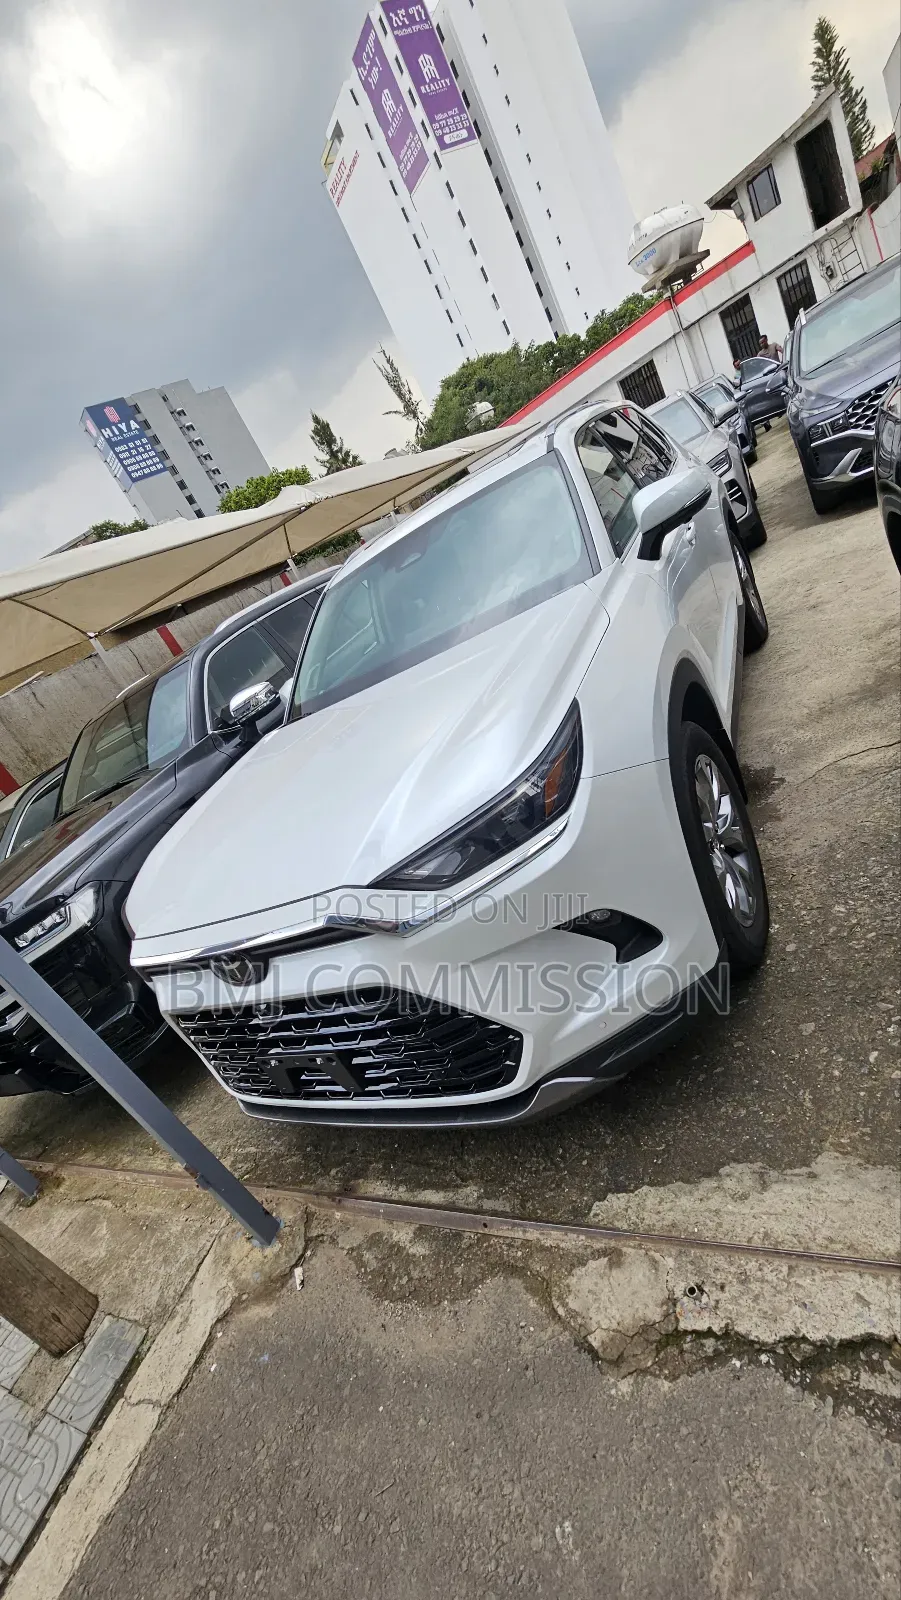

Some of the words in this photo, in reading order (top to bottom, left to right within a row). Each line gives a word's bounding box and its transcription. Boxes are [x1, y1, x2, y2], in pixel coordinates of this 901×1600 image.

[420, 78, 450, 94] REALITY
[387, 104, 404, 139] REALITY
[432, 122, 440, 130] 09
[330, 156, 347, 198] REALITY
[101, 419, 140, 439] HIYA
[123, 429, 139, 438] ESTATE
